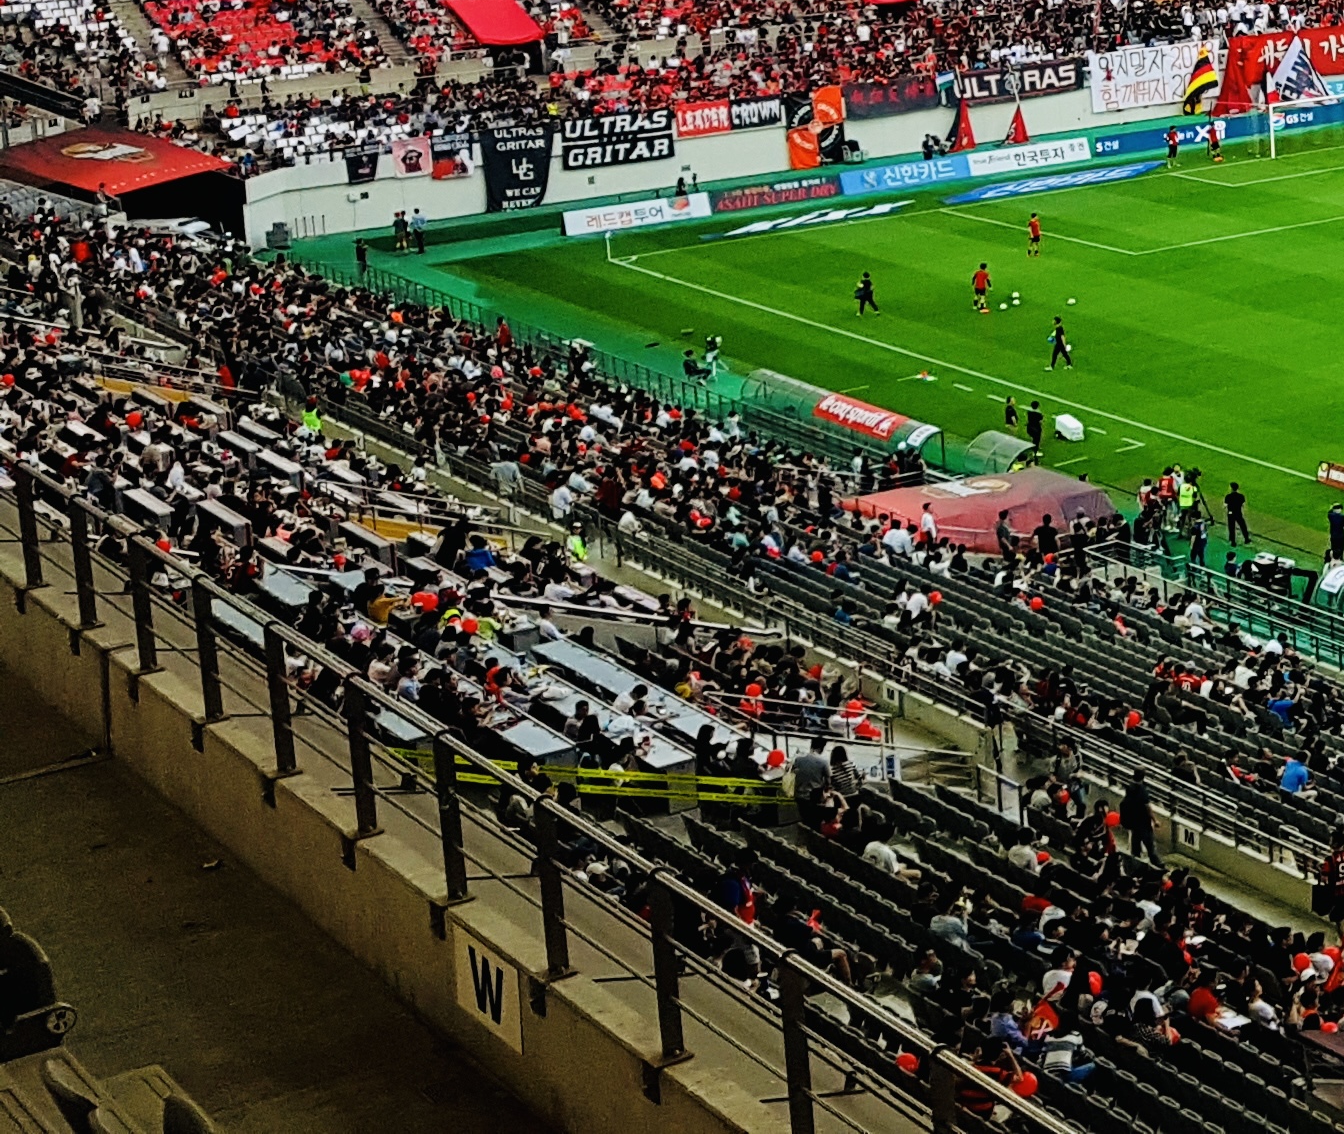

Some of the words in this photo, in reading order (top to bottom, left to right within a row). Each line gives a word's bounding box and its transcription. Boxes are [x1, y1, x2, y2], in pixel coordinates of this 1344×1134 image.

[493, 127, 544, 138] ULTRAS
[564, 110, 668, 138] ULTRAS
[496, 139, 546, 152] GRITAR
[568, 138, 669, 166] GRITAR
[1014, 147, 1065, 167] 한국투자
[883, 158, 956, 186] 신한카드
[585, 205, 665, 228] 레드캡투어
[1184, 828, 1195, 846] M
[467, 944, 504, 1026] W
